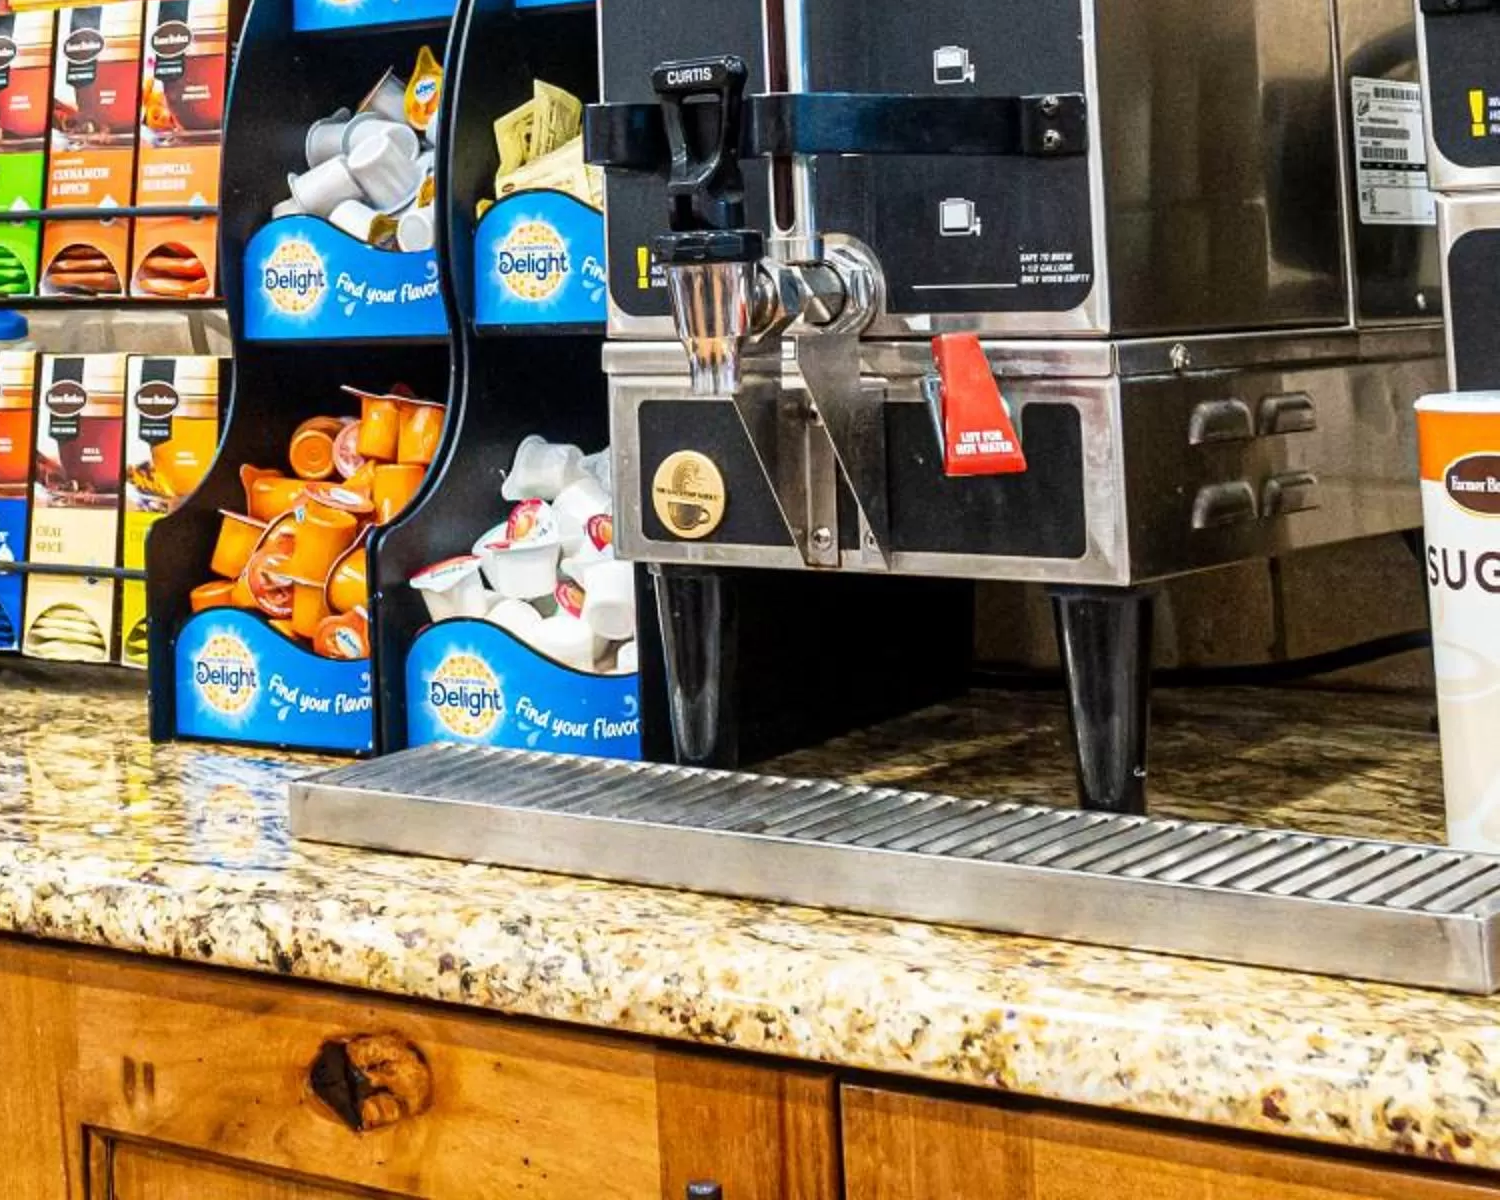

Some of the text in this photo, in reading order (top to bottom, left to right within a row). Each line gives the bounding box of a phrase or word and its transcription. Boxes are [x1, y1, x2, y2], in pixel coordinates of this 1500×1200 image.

[667, 67, 714, 85] CURTIS
[265, 267, 326, 296] Delight
[498, 250, 569, 281] Delight
[581, 255, 606, 281] Fin
[336, 271, 366, 300] Find
[365, 286, 398, 306] your
[1451, 475, 1485, 492] Farmer
[196, 659, 258, 696] Delight
[268, 672, 373, 716] Find your flavo
[430, 680, 503, 718] Delight
[514, 695, 640, 741] Find your flavor
